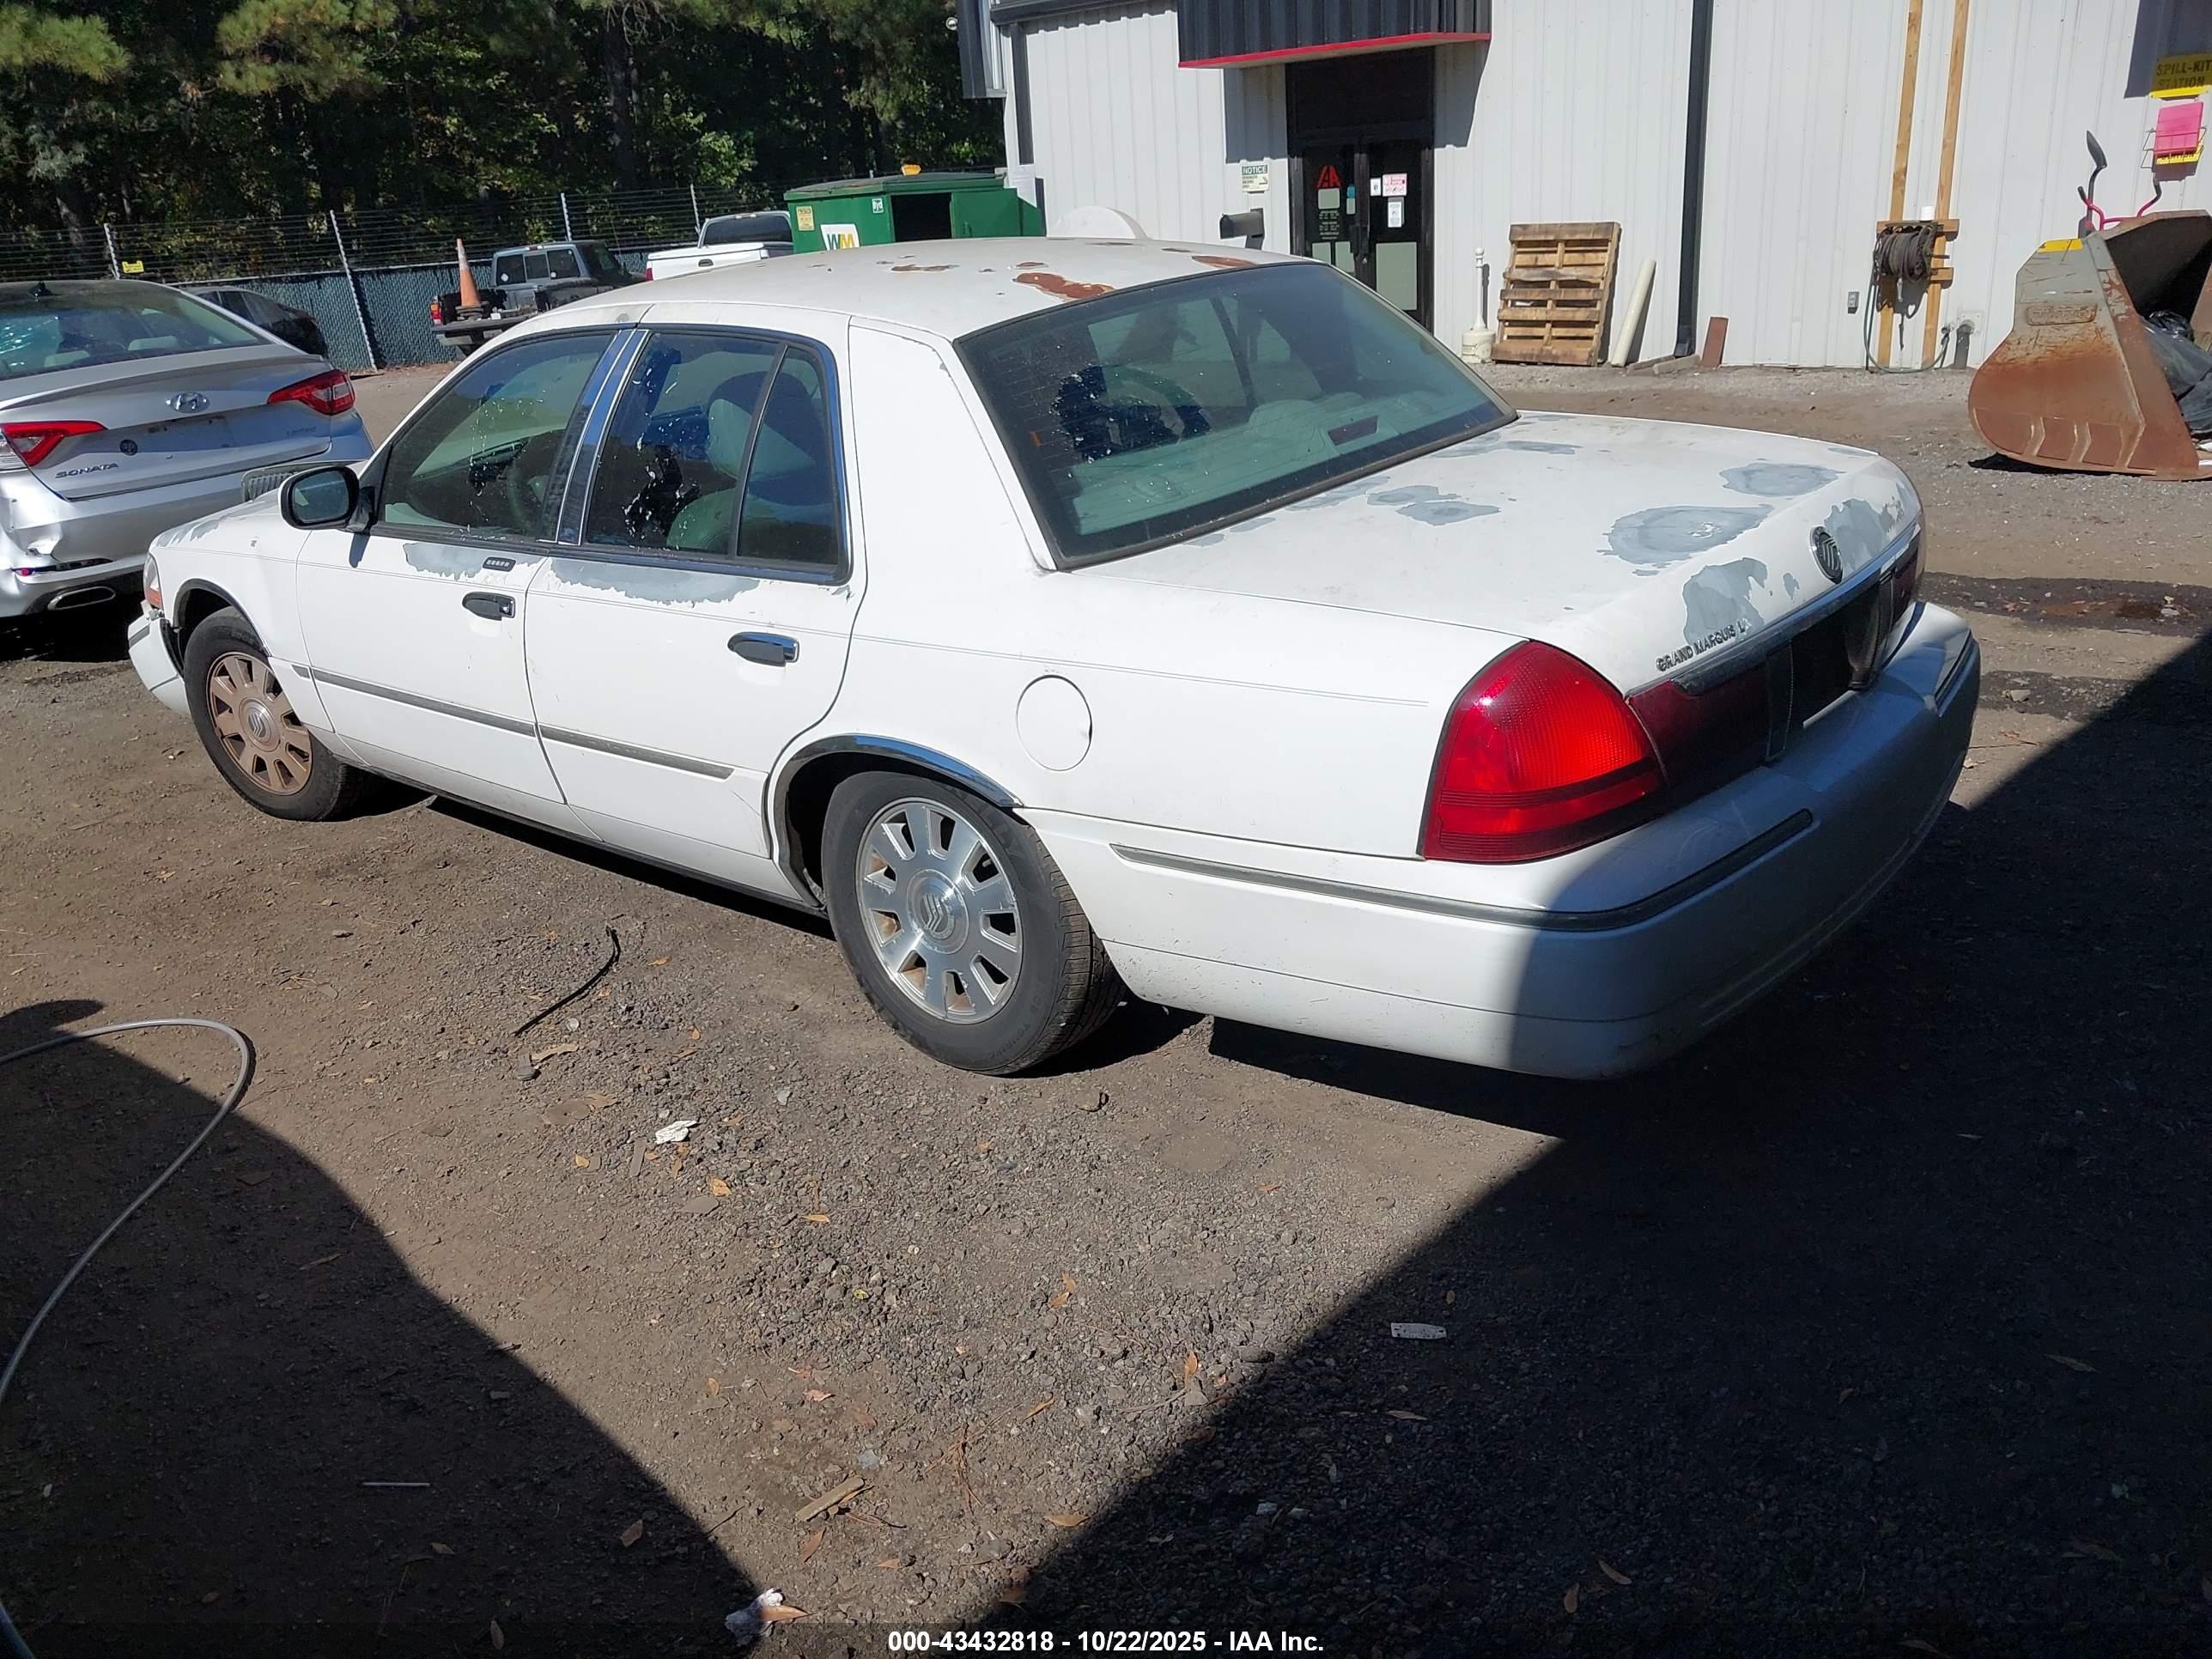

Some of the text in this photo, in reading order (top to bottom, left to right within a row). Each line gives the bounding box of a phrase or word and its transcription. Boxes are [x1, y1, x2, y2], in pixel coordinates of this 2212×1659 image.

[2157, 76, 2206, 89] STATION
[1243, 165, 1267, 174] NOTICE
[827, 234, 855, 251] WM
[55, 463, 118, 478] SONATA
[1656, 645, 1693, 672] GRAND
[1693, 624, 1736, 655] MARQUIS
